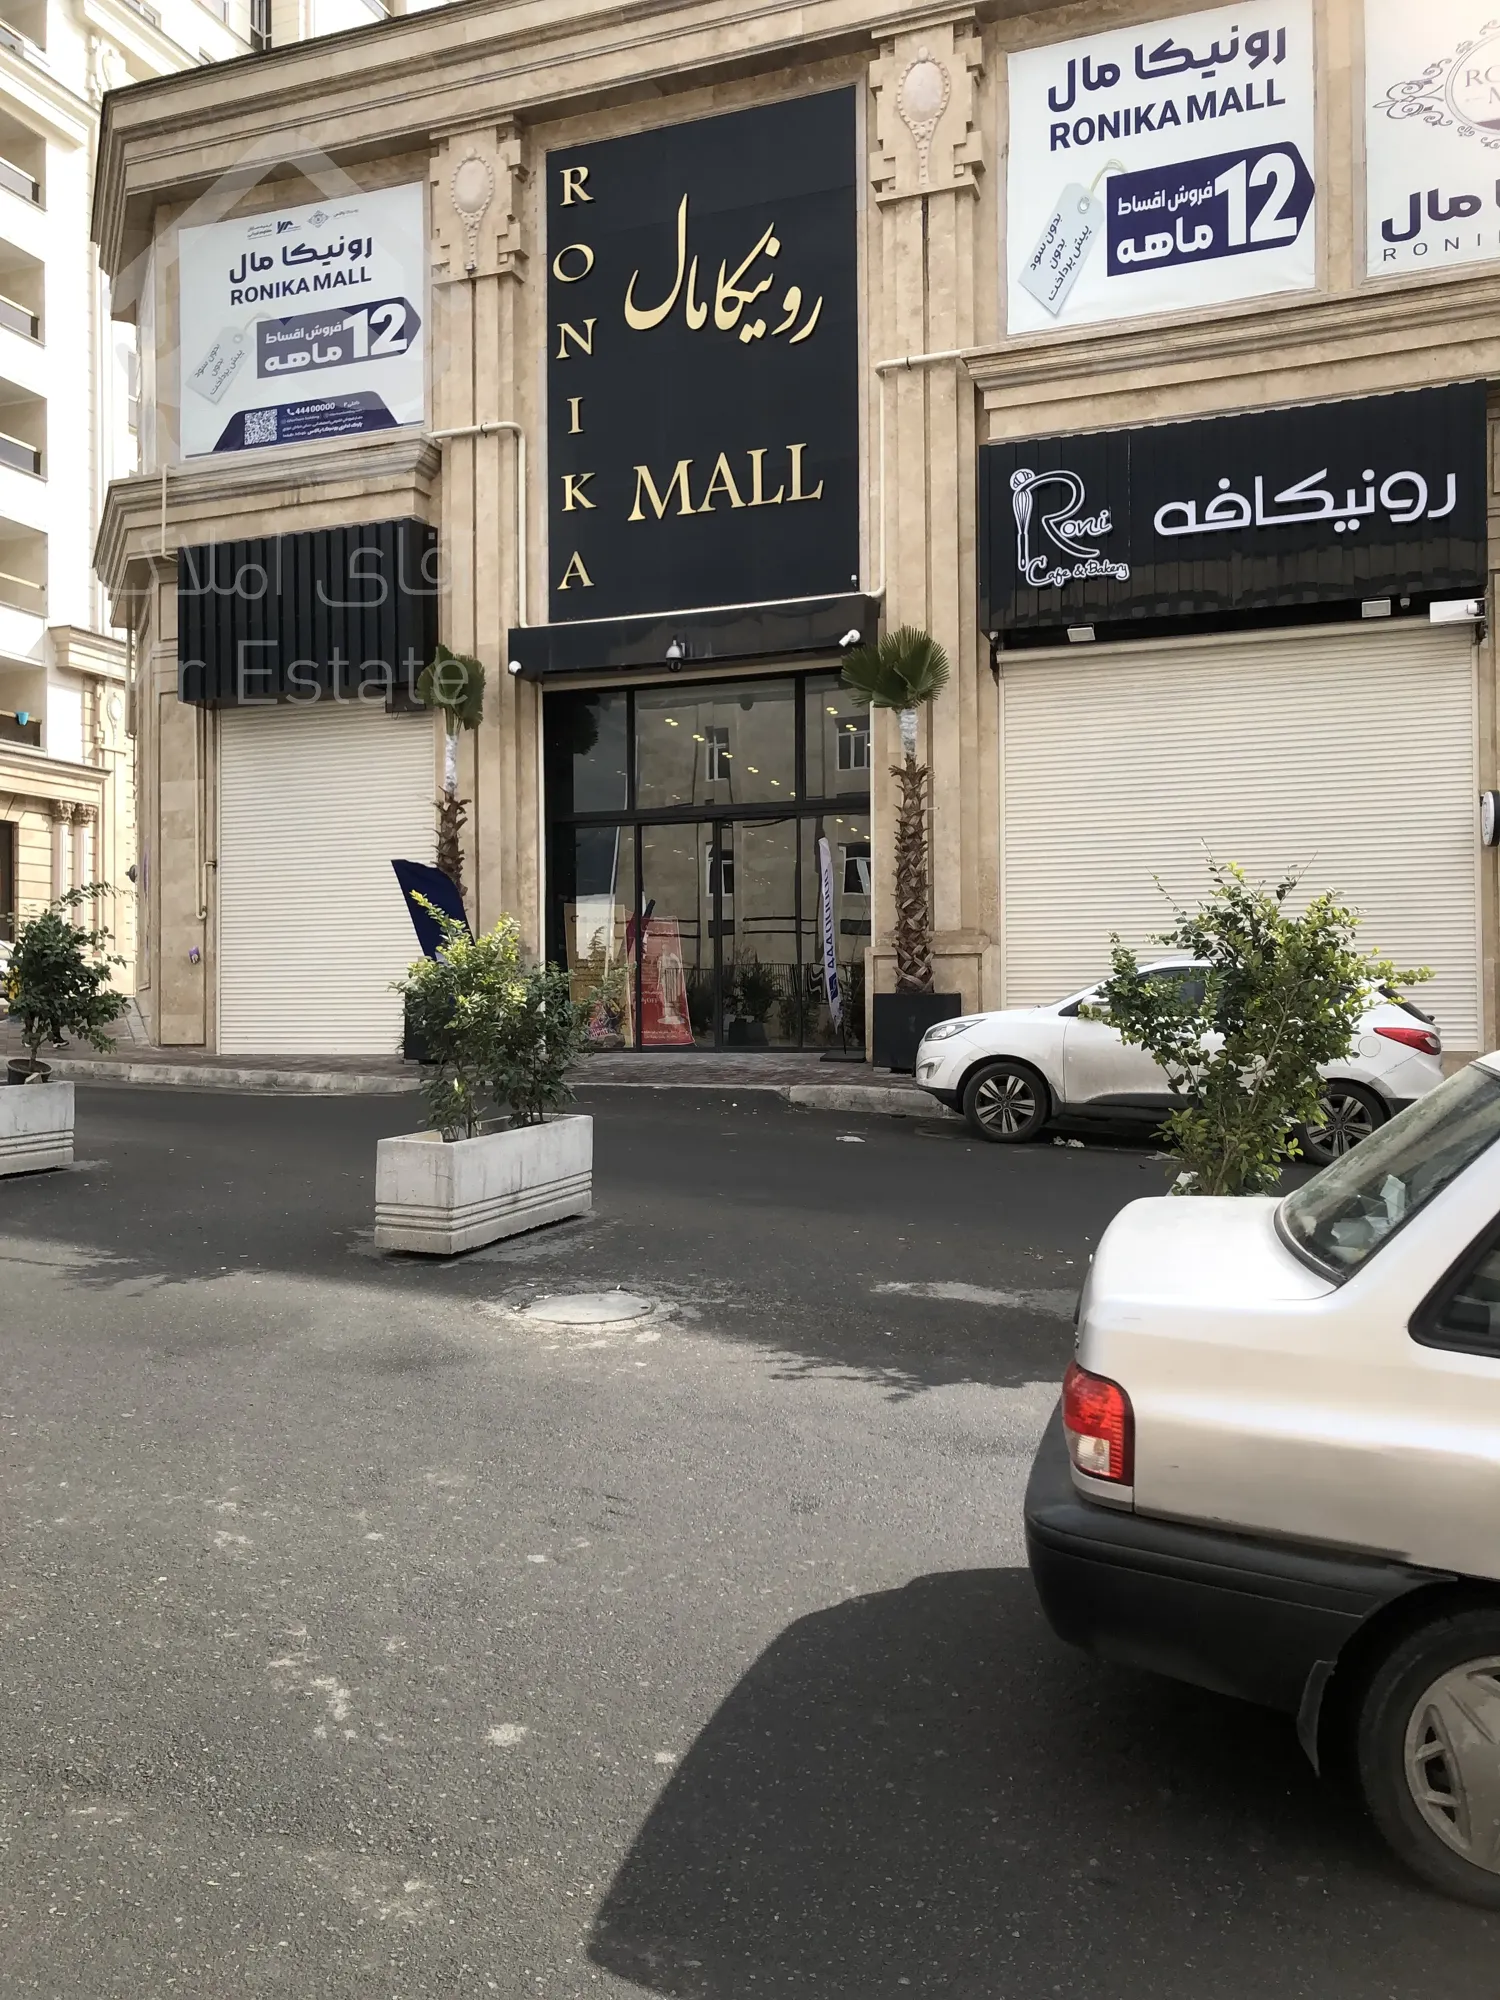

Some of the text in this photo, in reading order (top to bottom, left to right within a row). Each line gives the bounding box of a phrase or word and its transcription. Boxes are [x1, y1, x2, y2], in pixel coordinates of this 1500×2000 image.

[1048, 25, 1286, 113] رونیکا مال
[1050, 78, 1286, 151] RONIKA MALL
[1117, 183, 1214, 216] فروش اقساط
[1214, 152, 1298, 247] 12
[1381, 188, 1482, 243] مال
[229, 235, 373, 284] رونیکا مال
[1030, 213, 1062, 270] بدون سود
[1048, 225, 1092, 300] پیش پرداخت
[1049, 239, 1067, 269] بدون
[1116, 217, 1215, 264] ماهه
[1383, 230, 1500, 262] RONI
[230, 266, 372, 306] RONIKA MALL
[264, 342, 343, 372] ماهه
[265, 324, 342, 345] فروش اقساط
[342, 303, 409, 359] 12
[552, 166, 597, 592] RONIKA
[627, 443, 824, 521] MALL
[1011, 469, 1113, 568] Roni
[1073, 563, 1086, 578] &
[1086, 558, 1130, 580] Bakery
